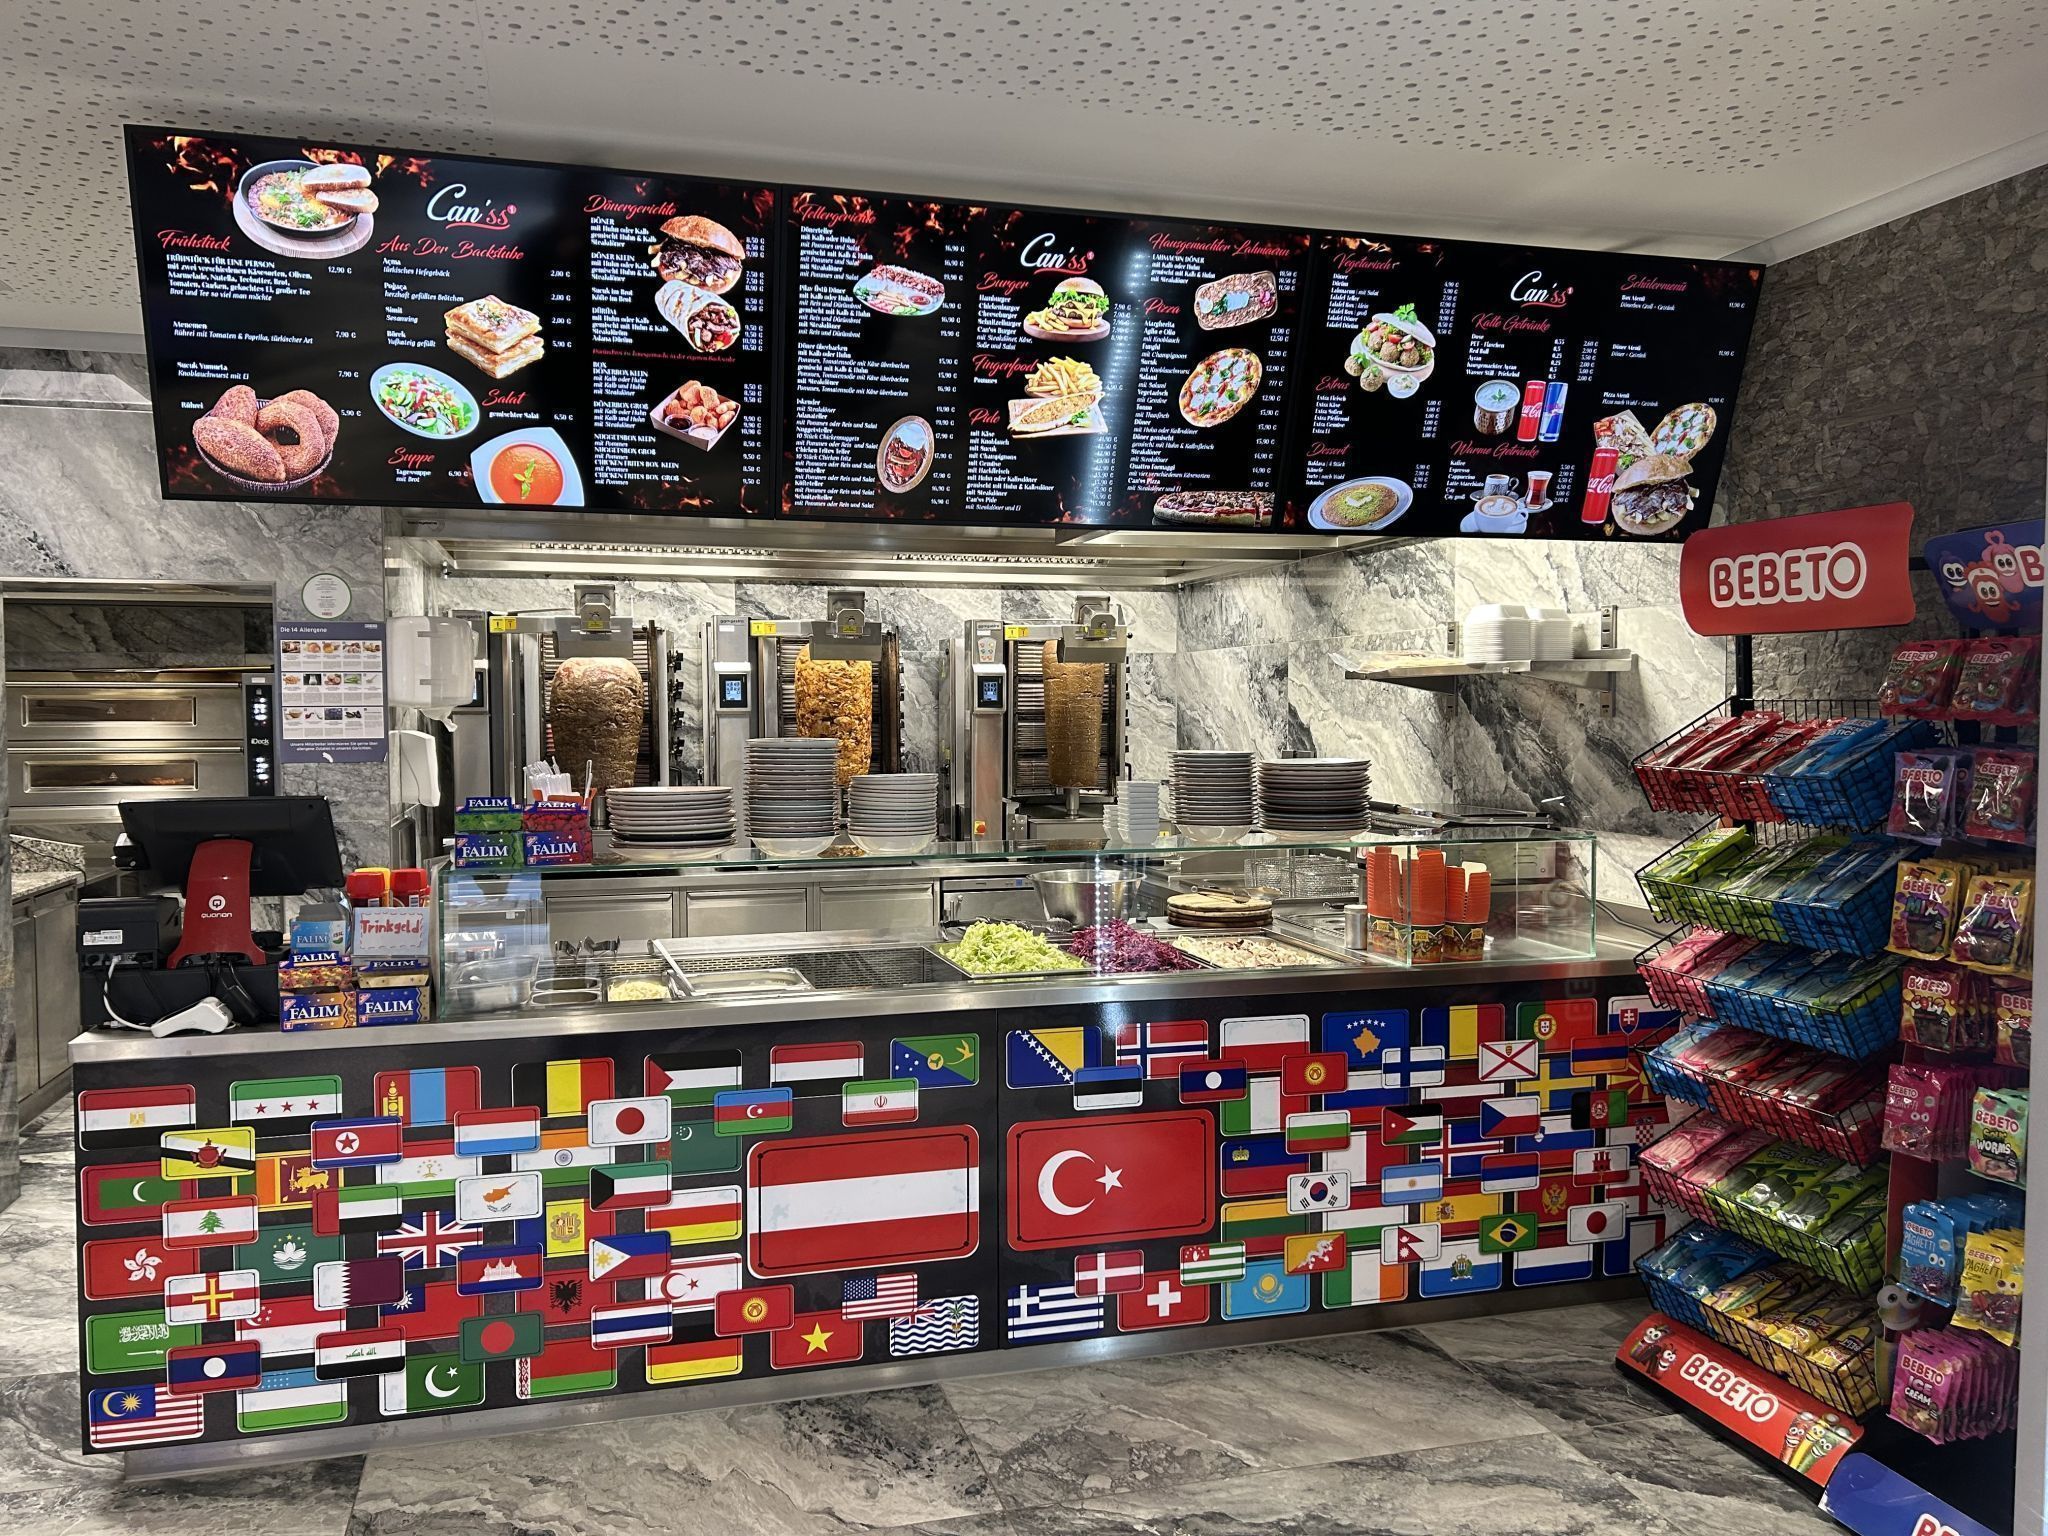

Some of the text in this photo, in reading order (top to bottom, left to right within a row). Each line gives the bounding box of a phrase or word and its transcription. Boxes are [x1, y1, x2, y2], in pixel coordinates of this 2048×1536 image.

[426, 183, 509, 230] Can'ss
[583, 194, 676, 220] Dönergerichte
[157, 229, 232, 251] Frühstück
[375, 235, 525, 260] Aus Der Backstube
[1148, 232, 1230, 255] Hausgemachter
[1020, 233, 1095, 275] Can'ss
[976, 271, 1030, 295] Burger
[1510, 270, 1574, 308] Can'ss
[1143, 297, 1181, 315] Pizza
[197, 330, 208, 338] mit
[209, 331, 236, 339] Tomaten
[244, 333, 269, 342] Paprika,
[972, 354, 1040, 378] Fingerfood
[1316, 375, 1350, 392] Extras
[482, 389, 528, 407] Salat
[968, 408, 1000, 425] Pide
[388, 446, 435, 469] Suppe
[1306, 441, 1352, 457] Dessert
[2015, 544, 2048, 587] B
[1709, 542, 1867, 608] BEBETO
[299, 627, 327, 635] Allergene
[1901, 767, 1943, 783] BEBETO
[468, 799, 509, 808] FALIM
[462, 845, 509, 858] FALIM
[532, 842, 578, 855] FALIM
[1902, 880, 1947, 896] BEBETO
[360, 919, 420, 934] Trinkgeld
[297, 935, 329, 943] FALIM
[293, 952, 337, 962] FALIM
[373, 960, 415, 968] FALIM
[365, 1000, 413, 1014] FALIM
[2001, 994, 2033, 1011] BEBE
[290, 1005, 340, 1020] FALIM
[1975, 1109, 2020, 1133] BEBETO
[1977, 1139, 2011, 1155] WORMS
[1906, 1221, 1934, 1238] BEBETO
[1904, 1232, 1936, 1252] PAGHETTI
[1968, 1249, 2002, 1264] BEBETO
[1966, 1259, 2003, 1278] PAGHETTI
[1902, 1355, 1945, 1388] BEBETO
[1680, 1353, 1779, 1423] BEBETO
[1908, 1375, 1933, 1395] ICE
[1904, 1387, 1931, 1407] CREAM
